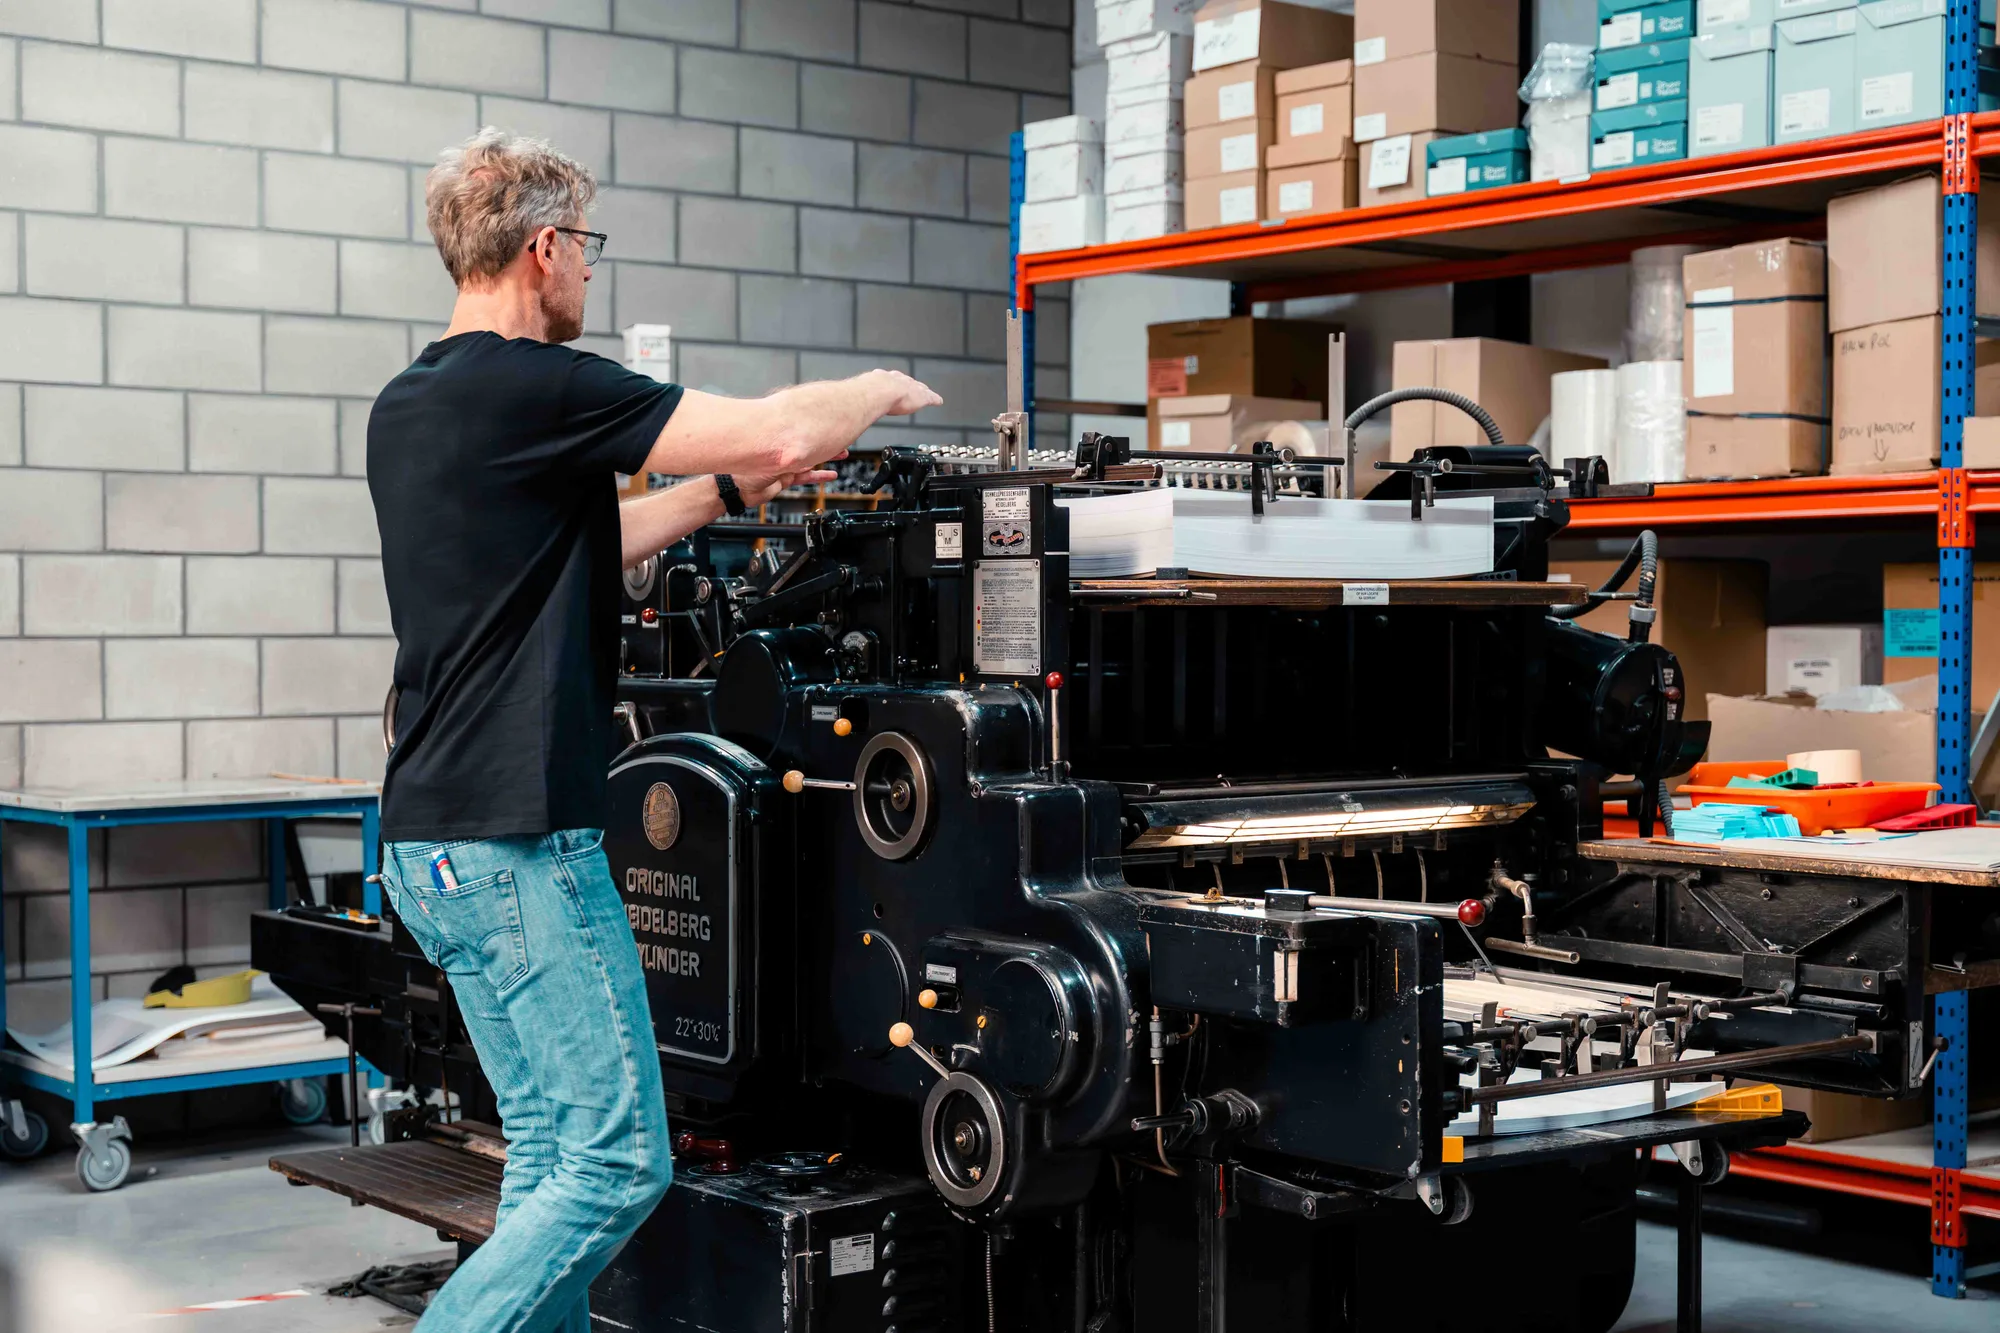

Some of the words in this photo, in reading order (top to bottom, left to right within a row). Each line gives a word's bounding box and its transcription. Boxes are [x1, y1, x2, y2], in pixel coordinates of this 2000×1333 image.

[953, 528, 959, 537] S
[626, 867, 701, 902] ORIGINAL
[624, 903, 711, 941] EIDELBERG
[635, 942, 700, 978] YLINDER
